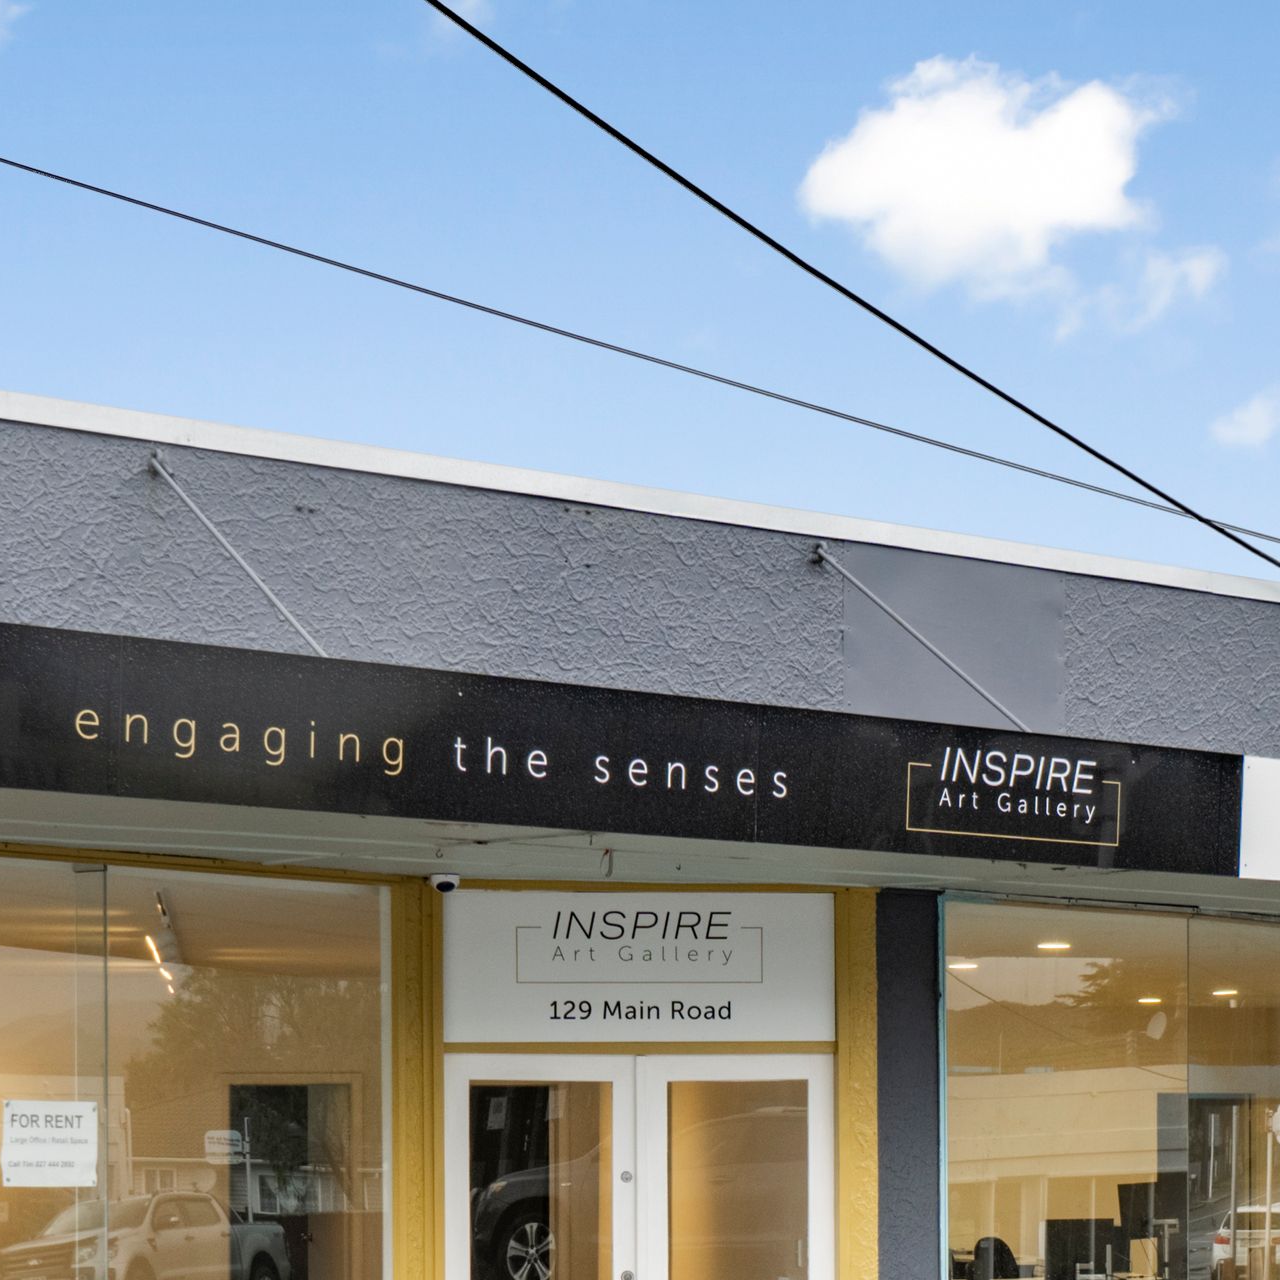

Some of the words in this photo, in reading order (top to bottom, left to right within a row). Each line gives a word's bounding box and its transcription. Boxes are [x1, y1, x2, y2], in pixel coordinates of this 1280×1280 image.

[75, 708, 407, 777] engaging
[454, 735, 549, 779] the
[593, 752, 790, 799] senses
[940, 746, 1097, 795] INSPIRE
[939, 787, 979, 810] Art
[997, 793, 1096, 824] Gallery
[552, 910, 732, 940] INSPIRE
[551, 946, 596, 962] Art
[618, 946, 733, 966] Gallery
[549, 1000, 592, 1020] 129
[602, 1000, 661, 1020] Main
[671, 1000, 732, 1020] Road
[10, 1113, 40, 1129] FOR
[44, 1114, 84, 1129] RENT
